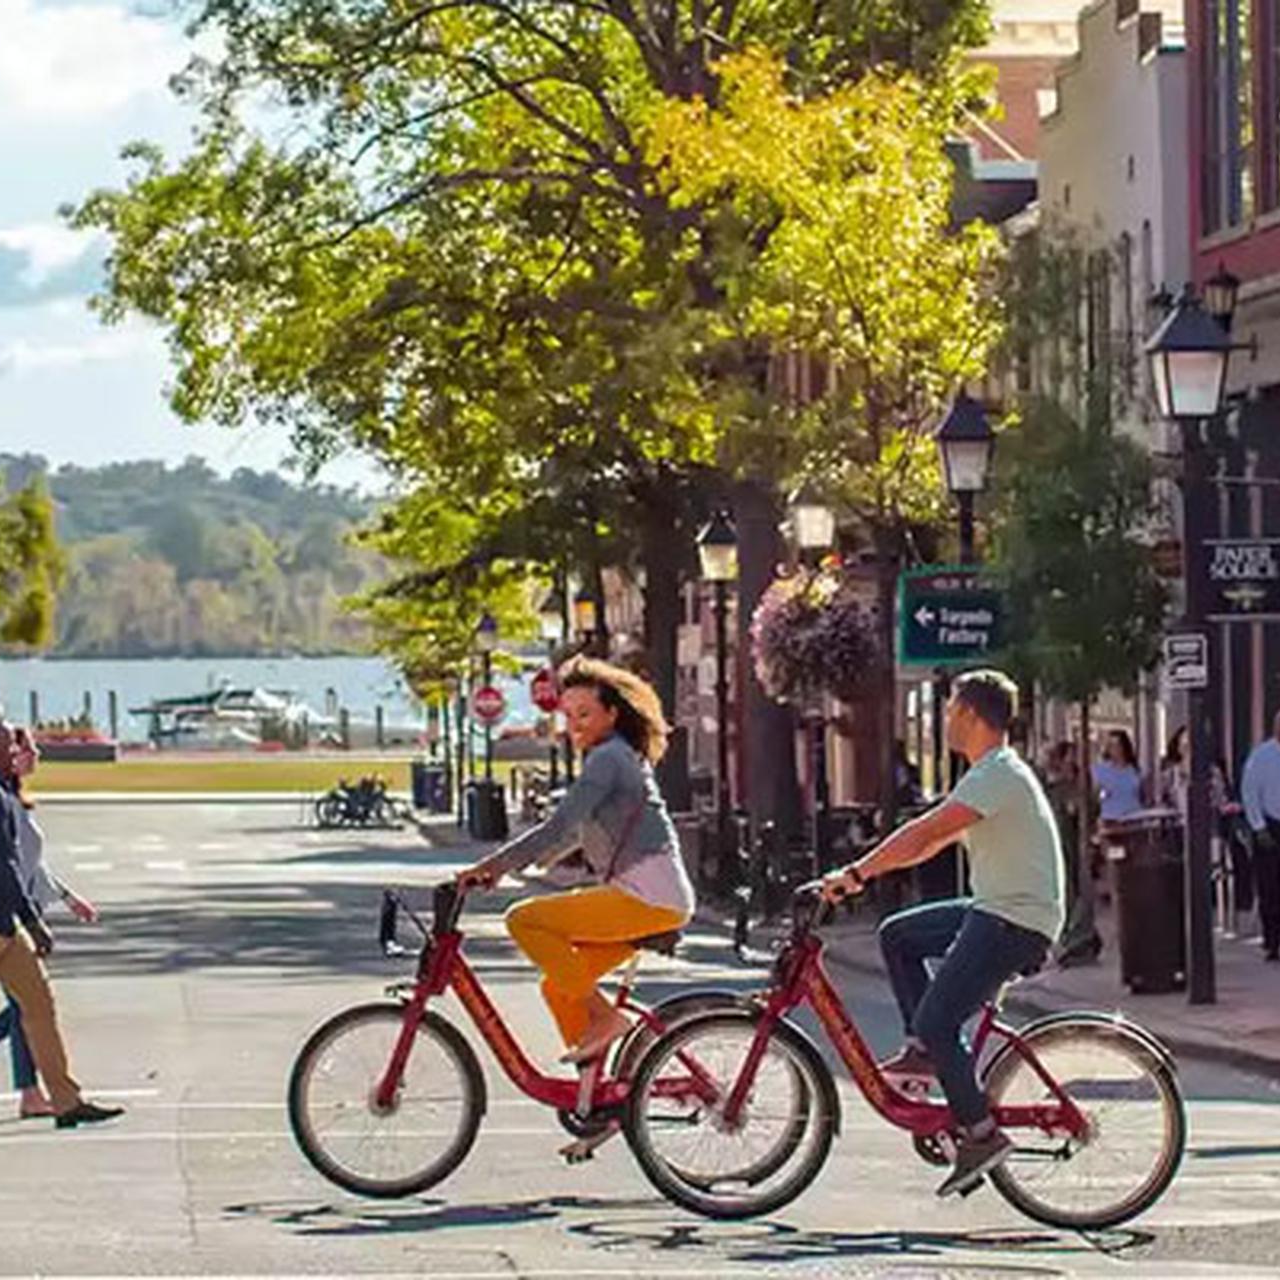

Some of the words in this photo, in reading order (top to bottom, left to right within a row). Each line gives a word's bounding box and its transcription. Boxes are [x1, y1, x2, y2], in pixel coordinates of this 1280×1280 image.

[1214, 546, 1272, 562] PAPER
[1209, 561, 1279, 580] SOURCE
[940, 607, 993, 625] Torpedo
[939, 627, 988, 650] Factory
